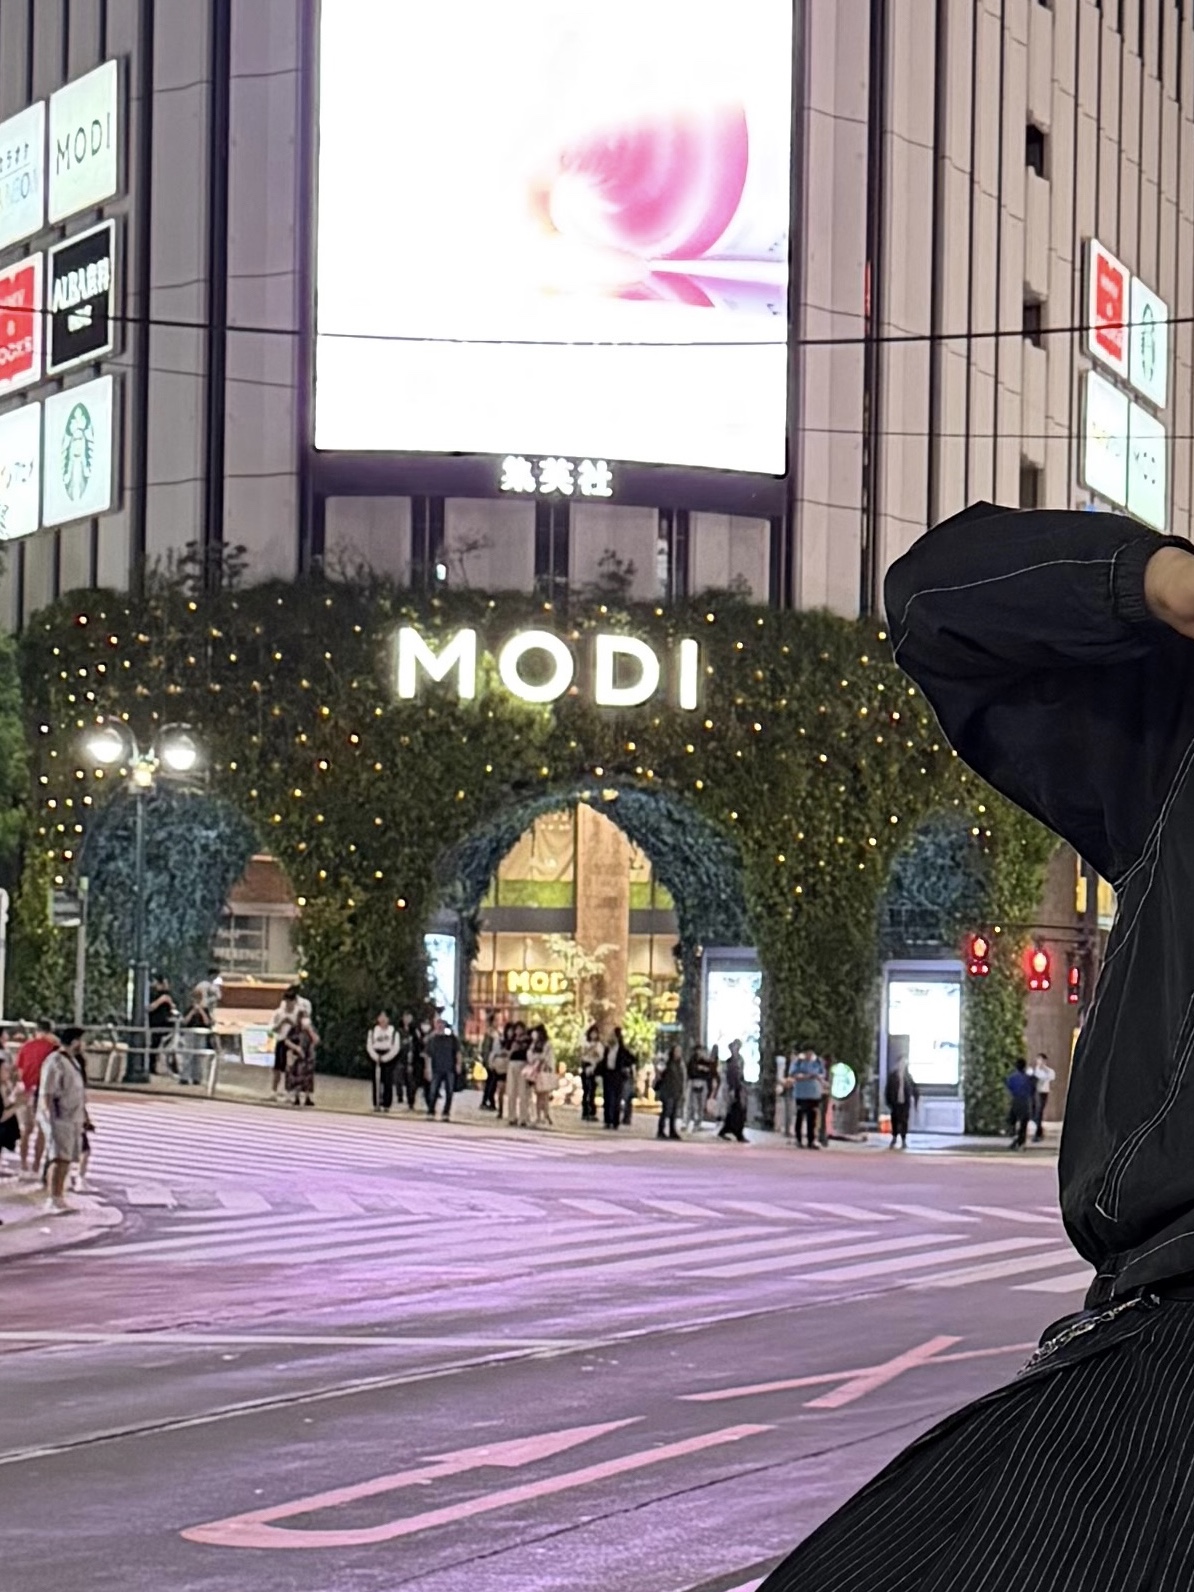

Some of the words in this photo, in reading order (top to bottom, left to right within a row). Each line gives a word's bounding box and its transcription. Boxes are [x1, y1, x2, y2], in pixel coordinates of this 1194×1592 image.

[56, 111, 111, 176] MODI
[500, 456, 613, 497] 集英社
[398, 626, 698, 710] MODI
